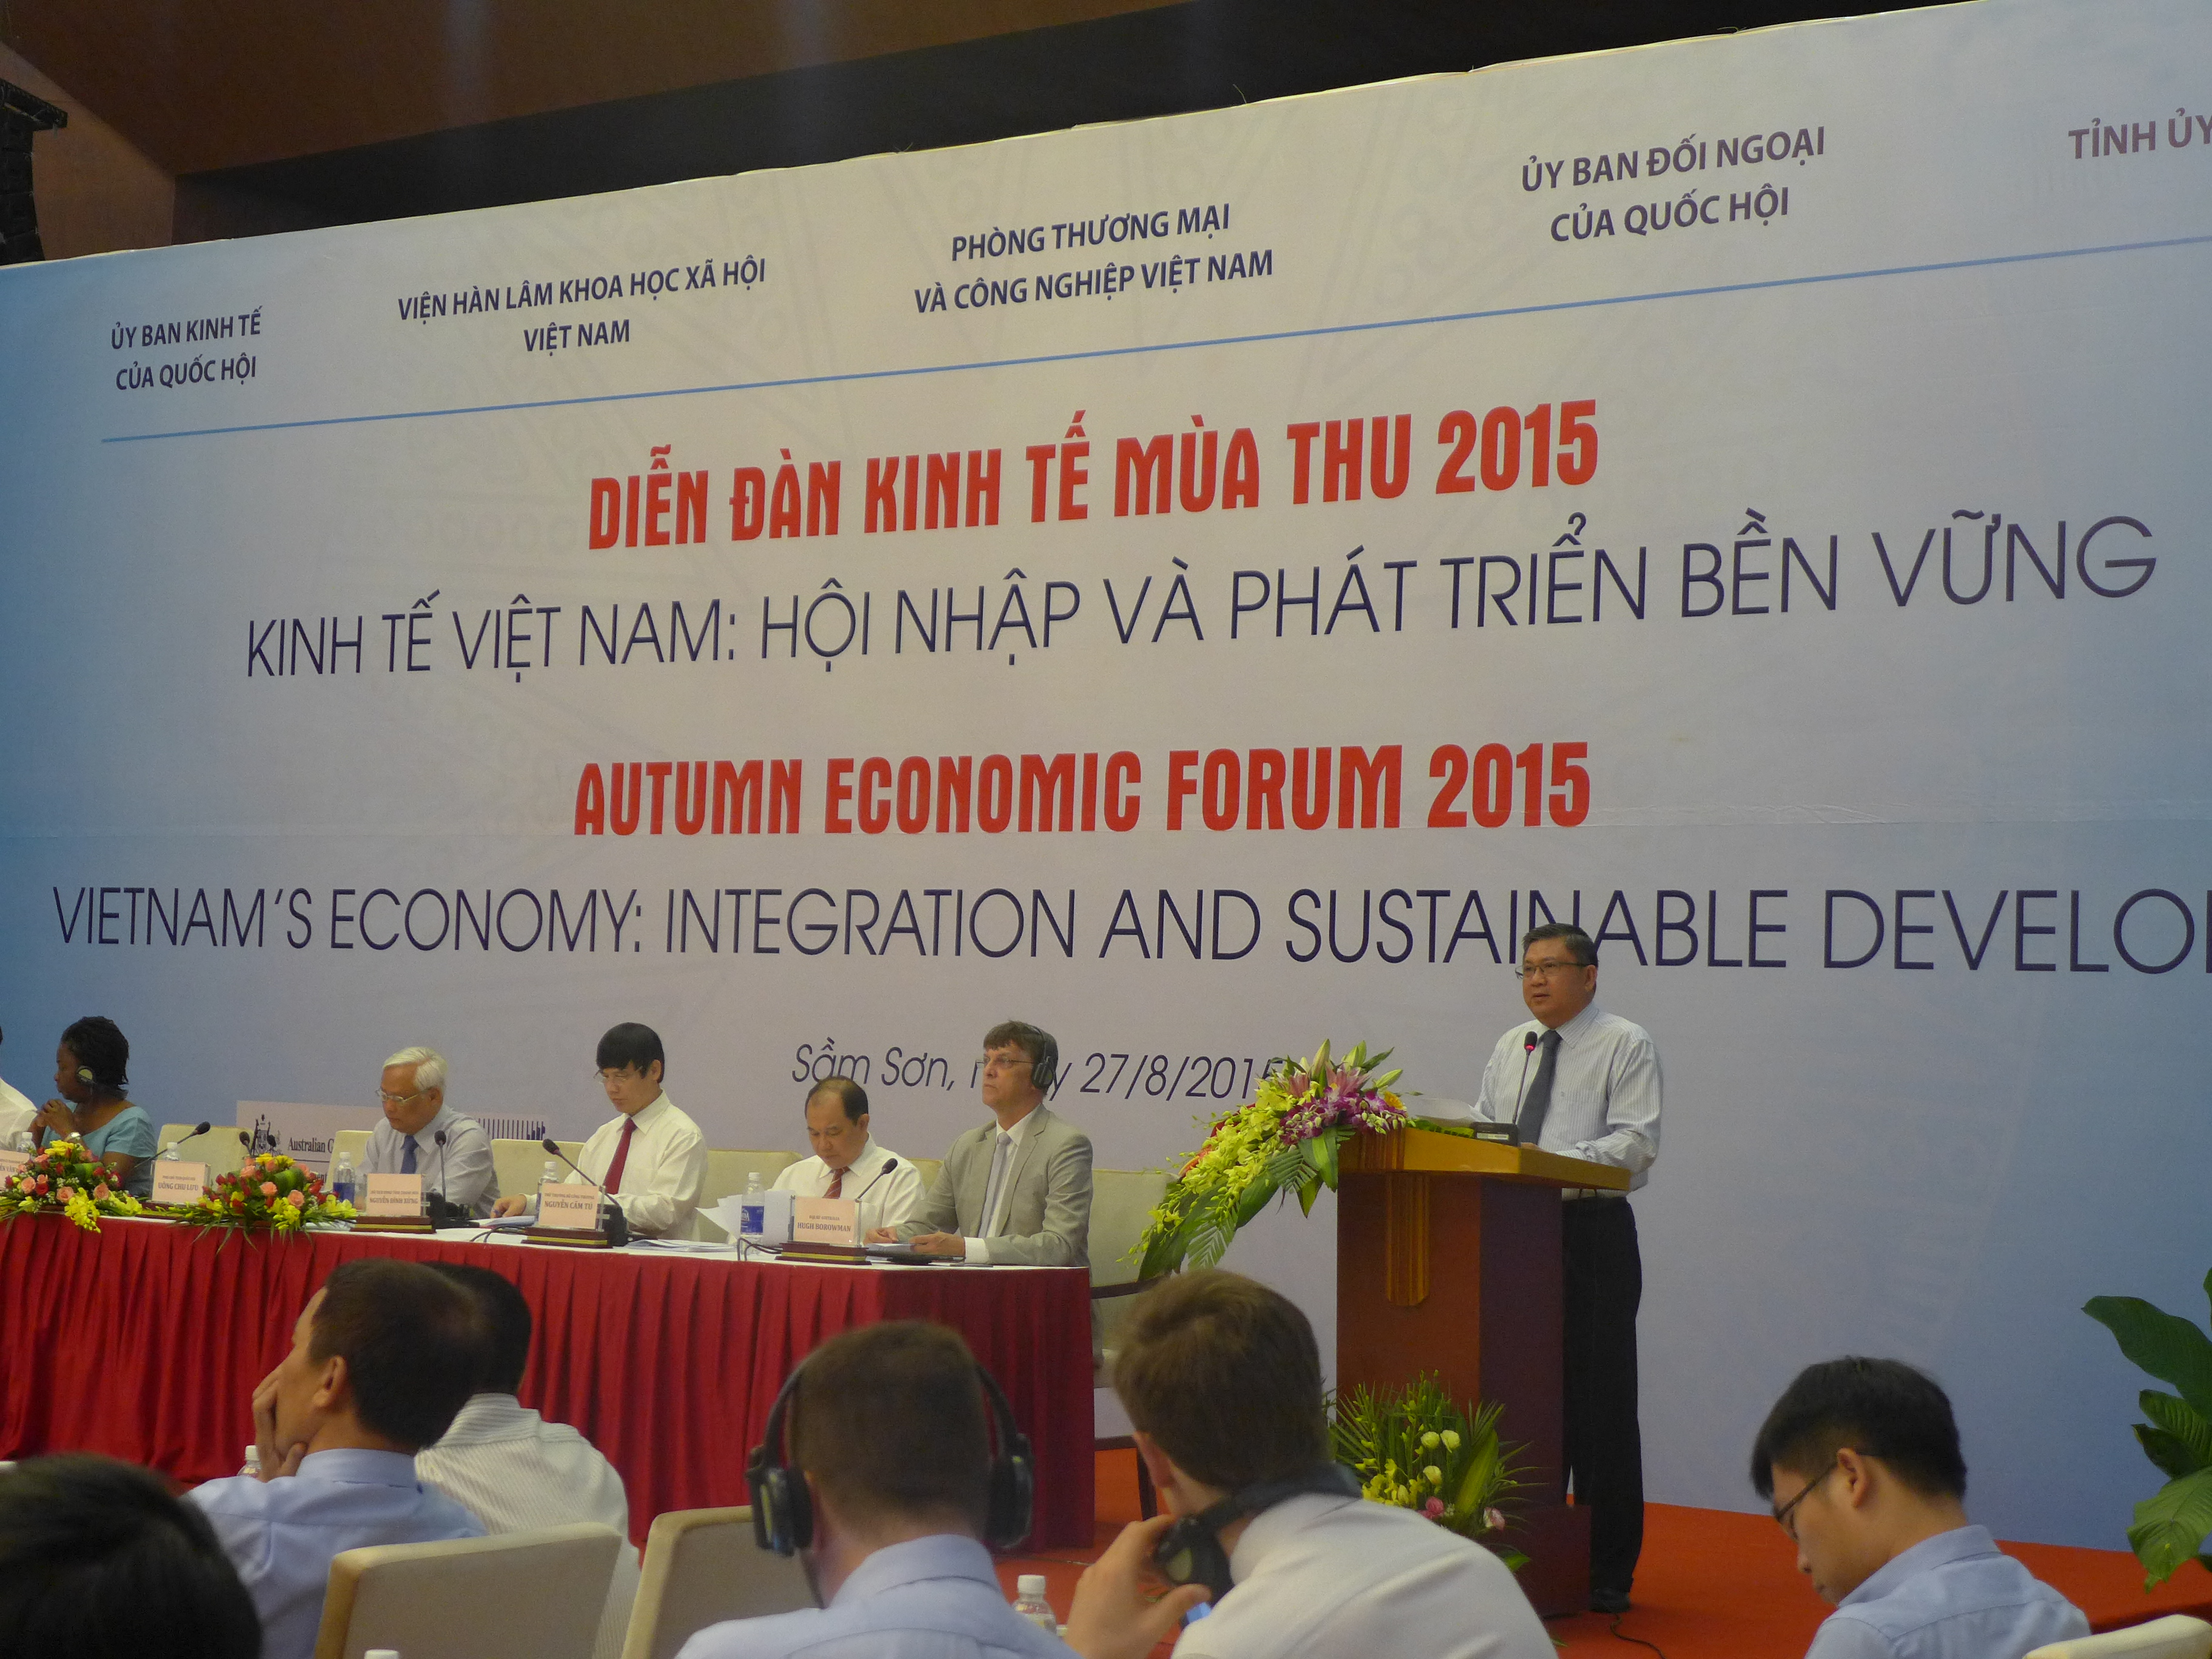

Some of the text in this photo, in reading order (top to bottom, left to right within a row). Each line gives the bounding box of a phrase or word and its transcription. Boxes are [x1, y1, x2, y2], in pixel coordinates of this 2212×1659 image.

[1521, 125, 1826, 193] ỦY BAN ĐỐI NGOẠI
[2067, 107, 2212, 160] TỈNH ỦY
[951, 202, 1230, 263] PHÒNG THƯƠNG MẠI
[1549, 182, 1789, 243] CỦA QUỐC HỘI
[397, 253, 766, 326] VIỆN HÀN LÂM KHOA HỌC XÃ HỘI
[913, 248, 1273, 315] VÀ CÔNG NGHIỆP VIỆT NAM
[110, 304, 263, 350] ỦY BAN KINH TẾ
[522, 318, 631, 358] VIỆT NAM
[115, 351, 257, 392] CỦA QUỐC HỘI
[588, 398, 1599, 551] DIỄN ĐÀN KINH TẾ MÙA THU 2015
[246, 506, 2158, 685] KINH TẾ VIỆT NAM: HỘI NHẬP VÀ PHÁT TRIỂN BỀN VỮNG
[573, 740, 1591, 837] AUTUMN ECONOMIC FORUM 2015
[52, 885, 313, 950] VIETNAM'S
[329, 887, 643, 954] ECONOMY:
[665, 886, 1076, 959] INTEGRATION
[1098, 888, 1262, 962] AND
[791, 1036, 871, 1085] Sầm
[880, 1045, 956, 1092] Sơn,
[287, 1136, 326, 1153] Australian
[815, 1223, 851, 1232] BOROWMAN
